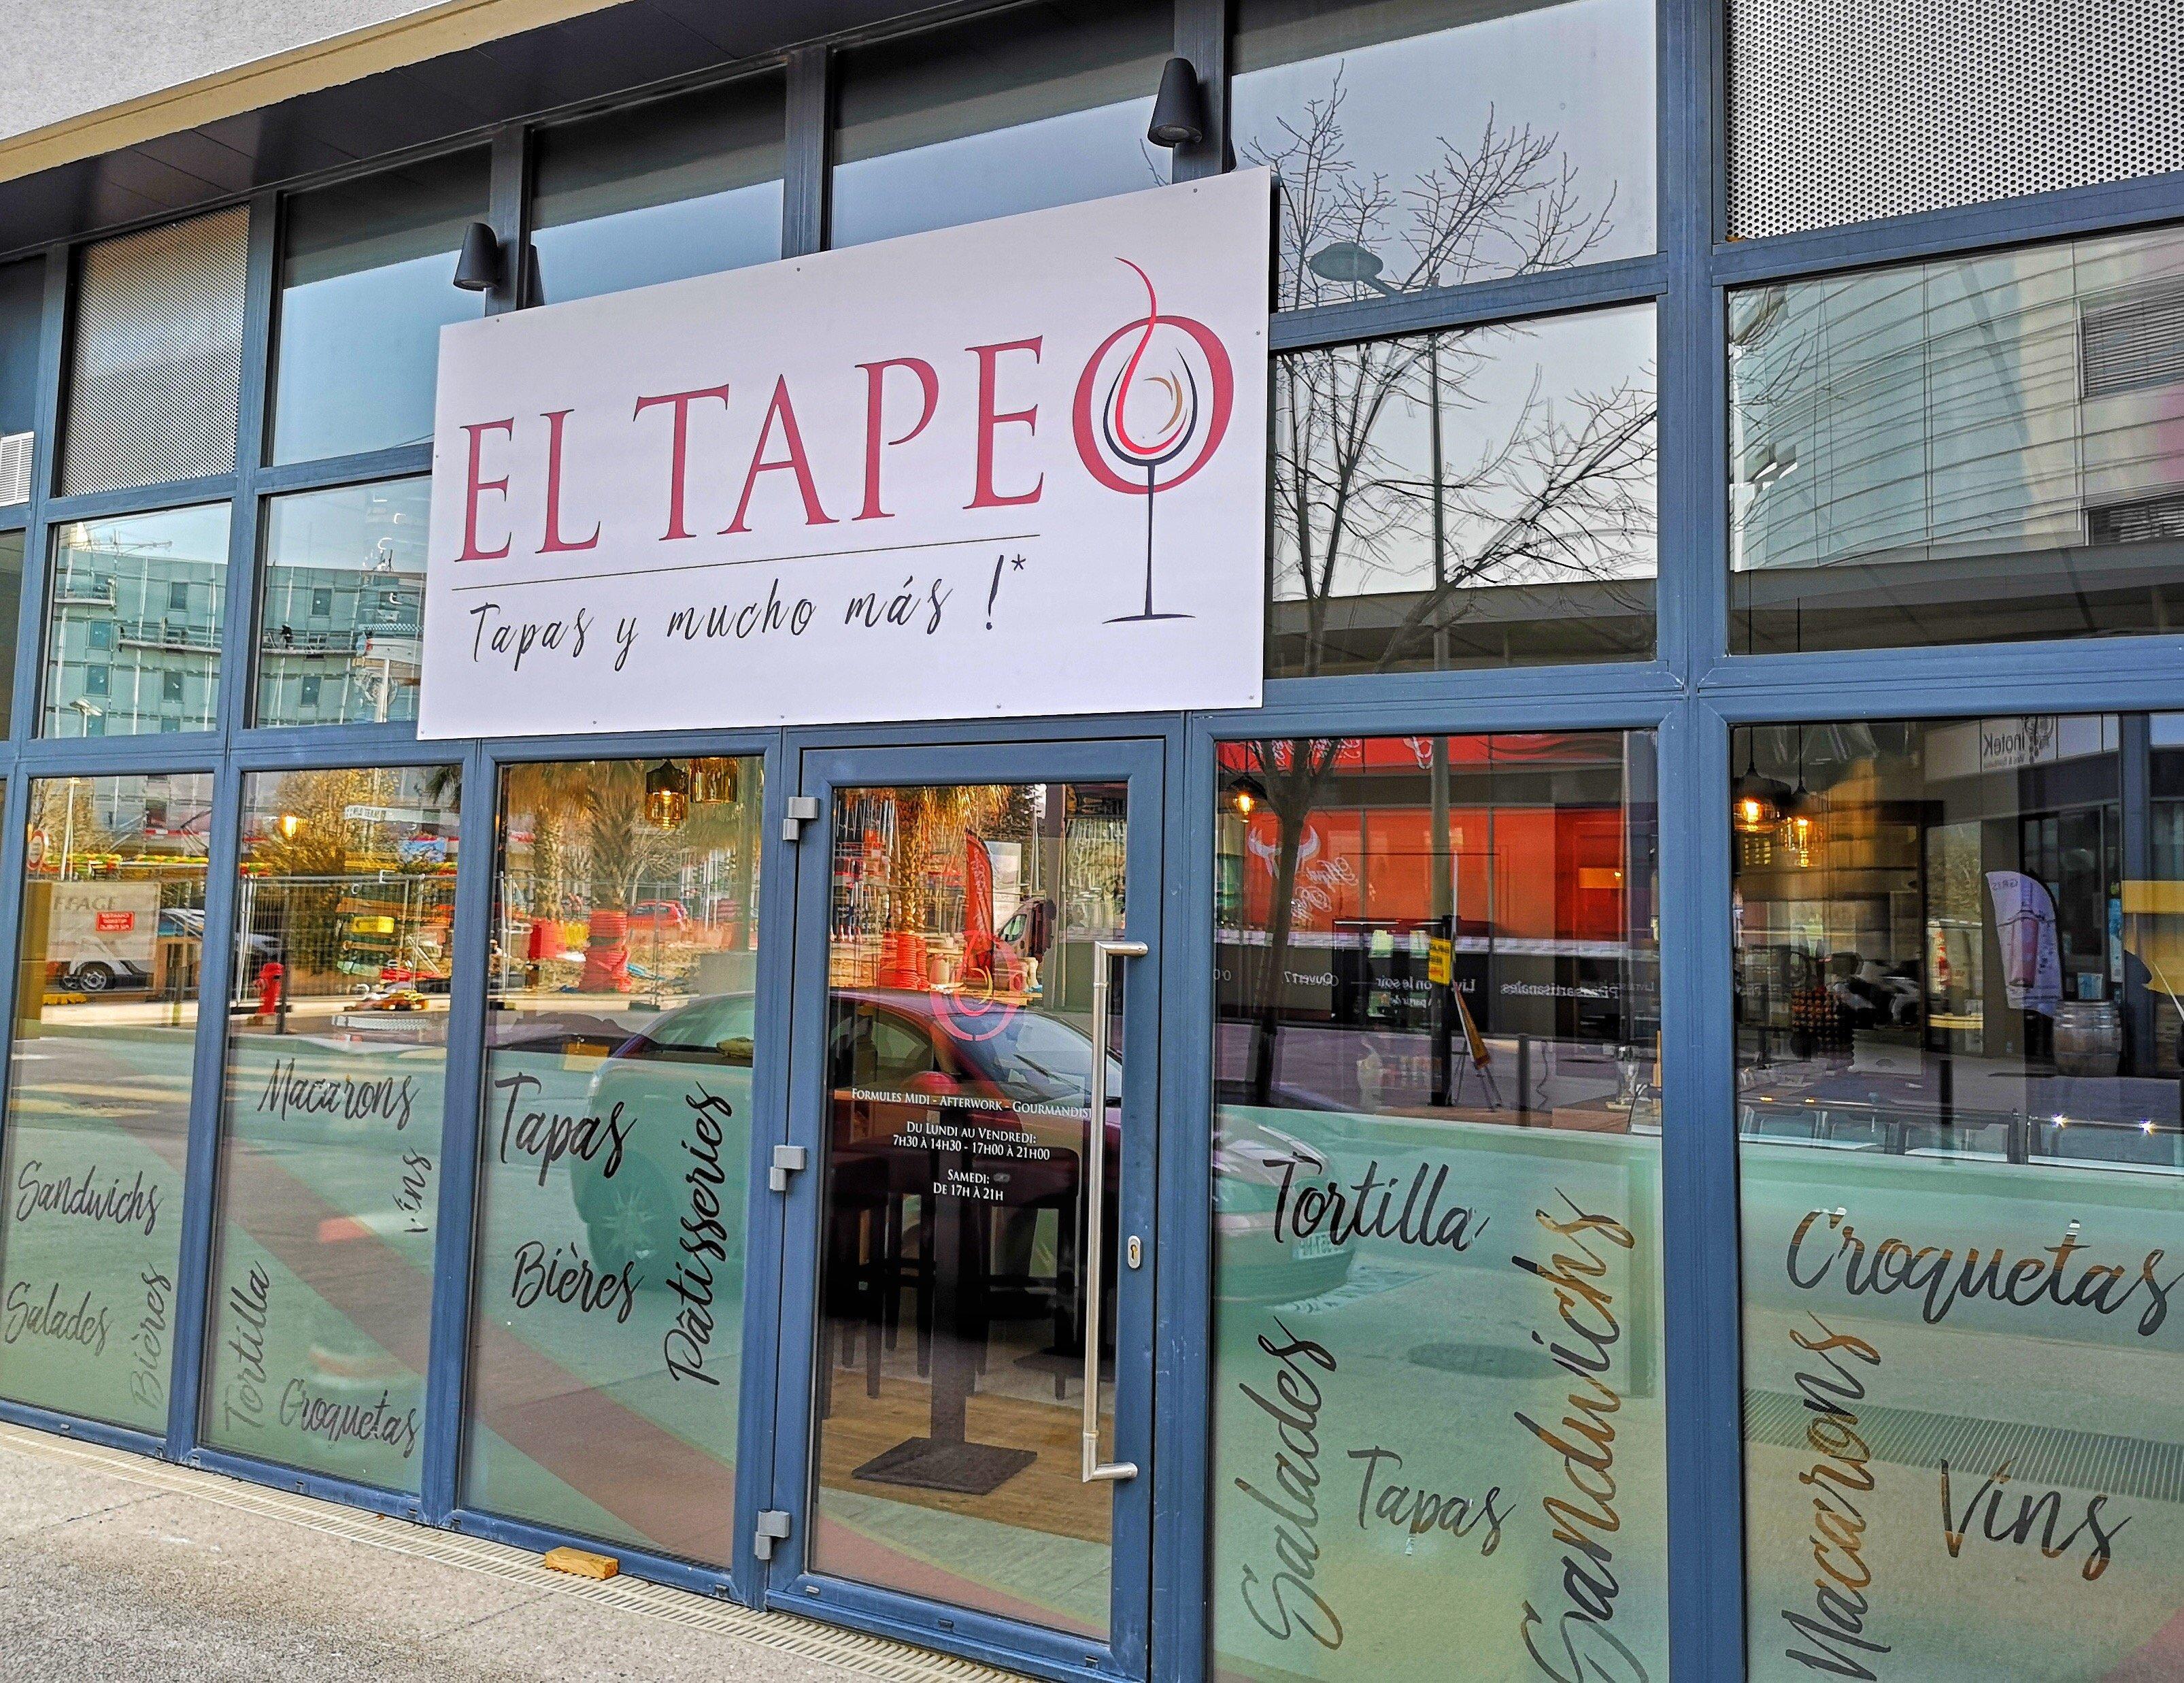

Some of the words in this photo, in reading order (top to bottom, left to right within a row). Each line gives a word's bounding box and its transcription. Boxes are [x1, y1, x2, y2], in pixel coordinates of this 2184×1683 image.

[454, 408, 601, 562] EL
[634, 314, 1234, 541] TAPEO
[469, 601, 591, 672] Tapas
[614, 612, 638, 672] y
[667, 578, 817, 640] mucho
[845, 575, 952, 635] más
[257, 1058, 420, 1130] Macarons
[494, 1071, 638, 1186] Tapas
[852, 1088, 902, 1103] FORMULES
[905, 1093, 930, 1105] MIDI
[939, 1096, 1003, 1112] AFTERWORK
[907, 1121, 923, 1133] DU
[926, 1122, 958, 1137] LUNDI
[961, 1128, 975, 1138] AU
[978, 1127, 1037, 1144] VENDREDI:
[17, 1160, 164, 1235] Sandwichs
[893, 1134, 918, 1148] 7H30
[920, 1137, 928, 1149] À
[930, 1138, 962, 1152] 14H30
[972, 1142, 1004, 1156] 17H00
[1007, 1145, 1014, 1157] À
[1016, 1146, 1051, 1161] 21H00
[933, 1182, 948, 1195] DE
[952, 1184, 971, 1197] 17H
[973, 1186, 981, 1199] À
[983, 1187, 1004, 1201] 21H
[947, 1169, 990, 1184] SAMEDI:
[664, 1081, 733, 1386] Pâtisseries
[1262, 1151, 1490, 1252] Tortilla
[5, 1282, 112, 1357] Salades
[512, 1240, 645, 1323] Bières
[1786, 1207, 2184, 1337] Croquetas
[130, 1262, 172, 1411] Bières
[226, 1261, 274, 1432] Tortilla
[281, 1378, 424, 1458] Croquetas
[1512, 1187, 1649, 1683] Sandwichs
[1234, 1315, 1344, 1652] Salades
[1347, 1445, 1517, 1557] Tapas
[1781, 1310, 1892, 1683] Macarons
[1940, 1457, 2132, 1580] Vins
